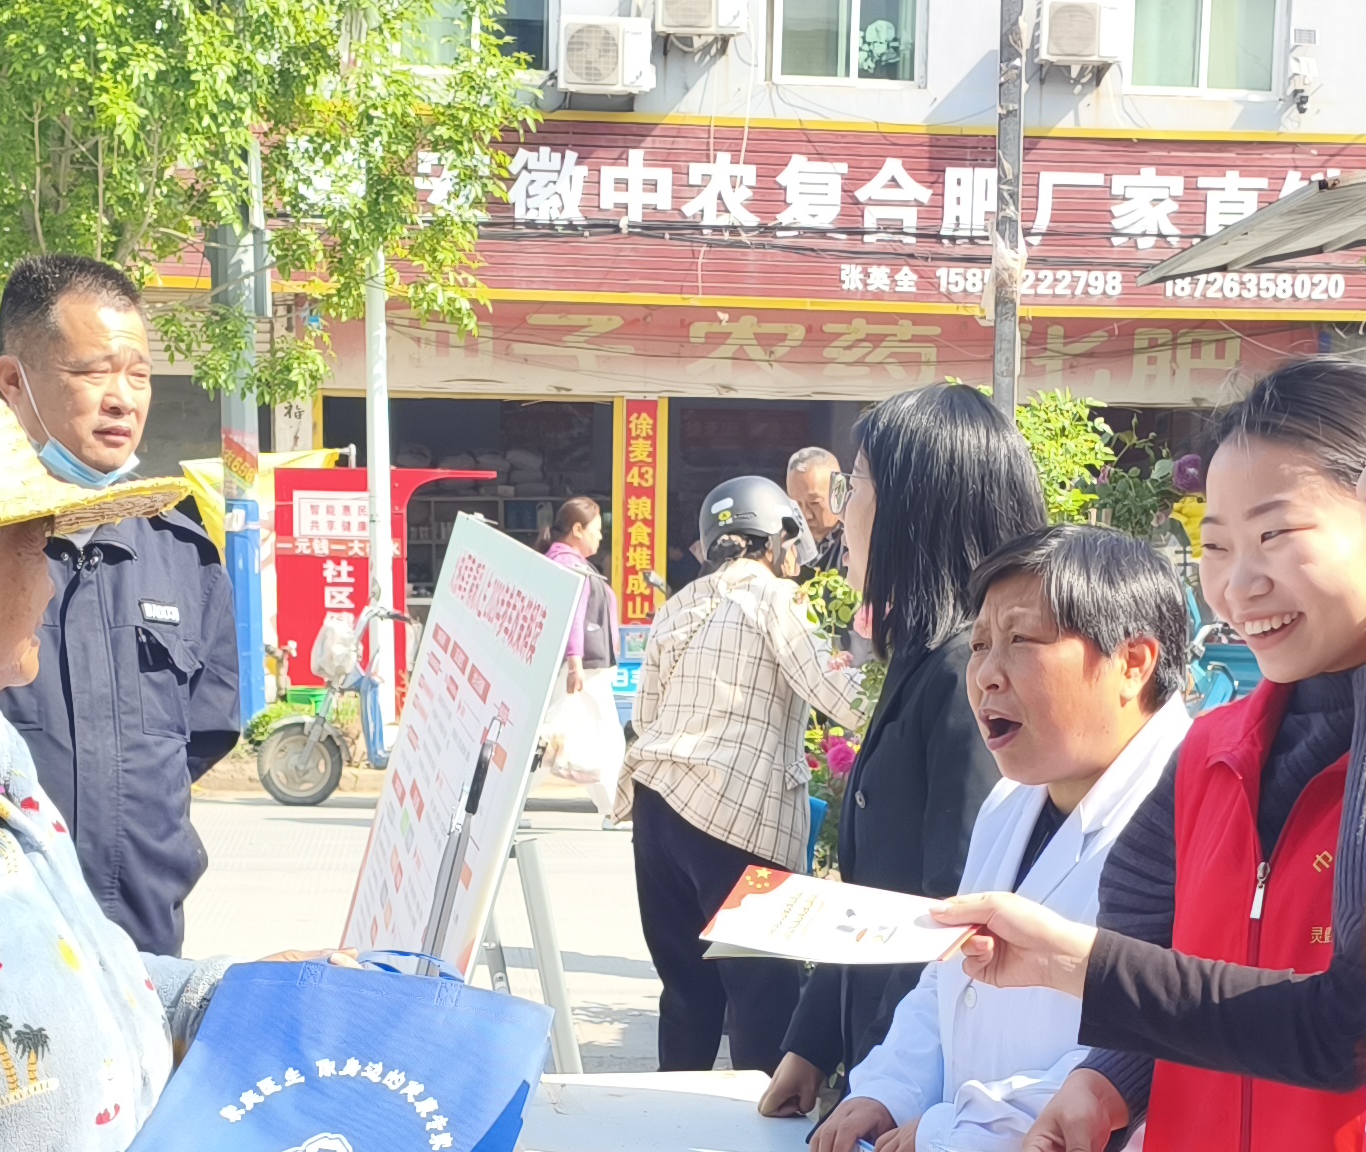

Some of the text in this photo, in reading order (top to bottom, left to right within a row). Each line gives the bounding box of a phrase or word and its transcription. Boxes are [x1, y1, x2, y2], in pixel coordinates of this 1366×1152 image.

[414, 146, 1341, 250] 安徽中农复合肥厂家直
[840, 264, 1345, 300] 张英全 158222798 18726358020
[626, 496, 652, 619] 粮食堆成山
